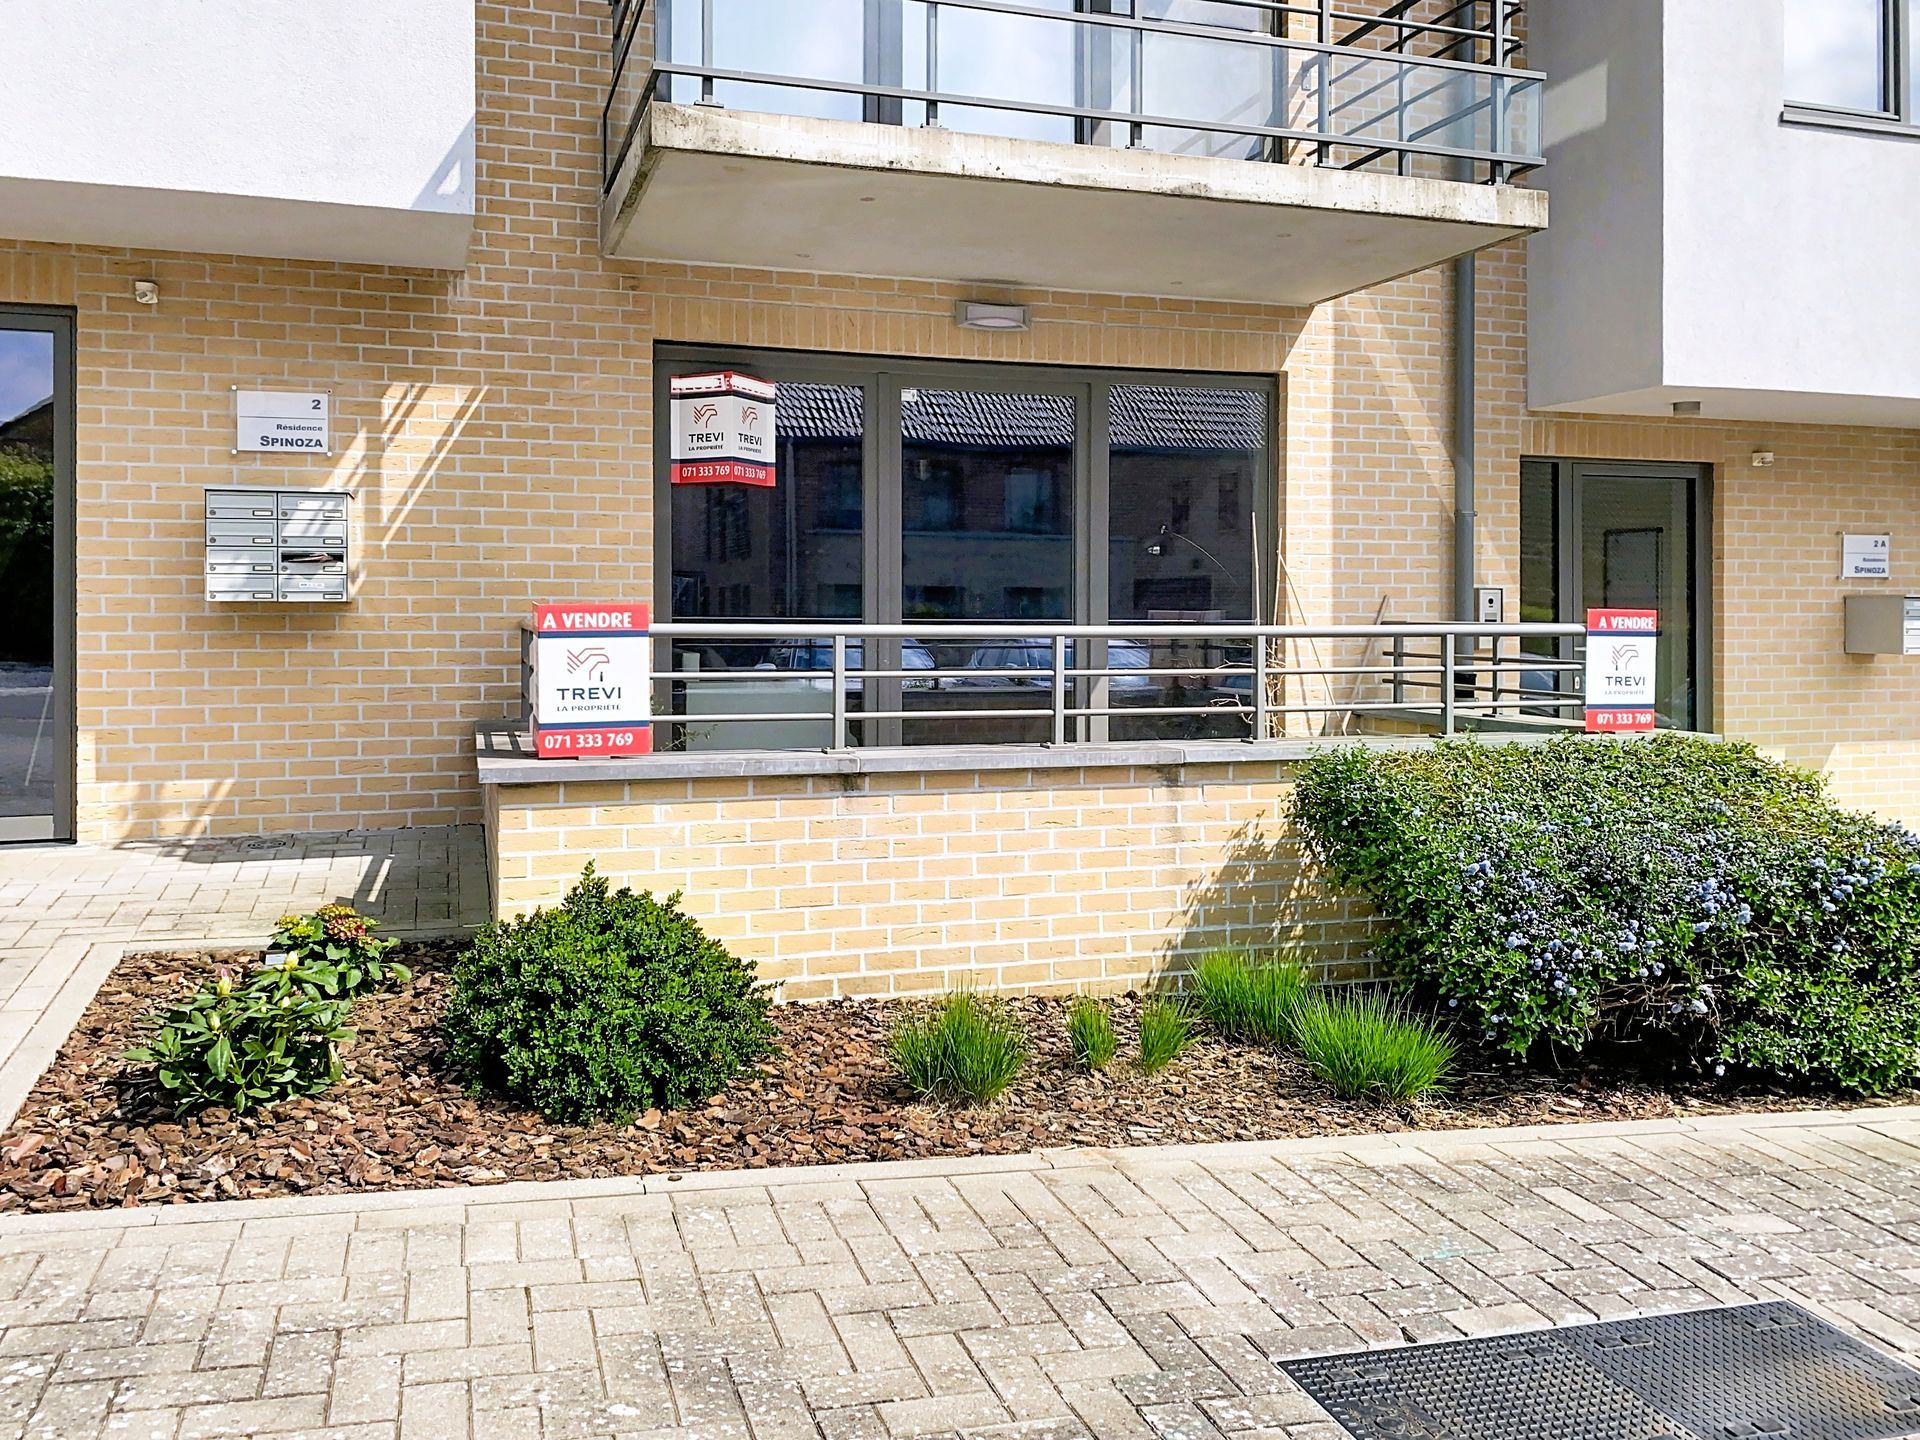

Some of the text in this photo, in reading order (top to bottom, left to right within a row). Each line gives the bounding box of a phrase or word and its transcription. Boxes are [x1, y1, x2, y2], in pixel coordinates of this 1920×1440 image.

[311, 399, 321, 410] 2
[260, 435, 323, 448] SPINOZA
[688, 432, 724, 443] TREVI
[738, 433, 762, 446] TREVI
[682, 465, 730, 477] 071 333 769
[734, 466, 744, 476] 071
[745, 467, 755, 478] 333
[1854, 566, 1886, 574] SPINOZA
[543, 612, 632, 629] A VENDRE
[1599, 616, 1654, 629] A VENDRE
[1605, 676, 1646, 686] TREVI
[556, 686, 622, 700] TREVI
[1597, 713, 1652, 724] 071 333 769
[544, 733, 634, 749] 071 333 769
